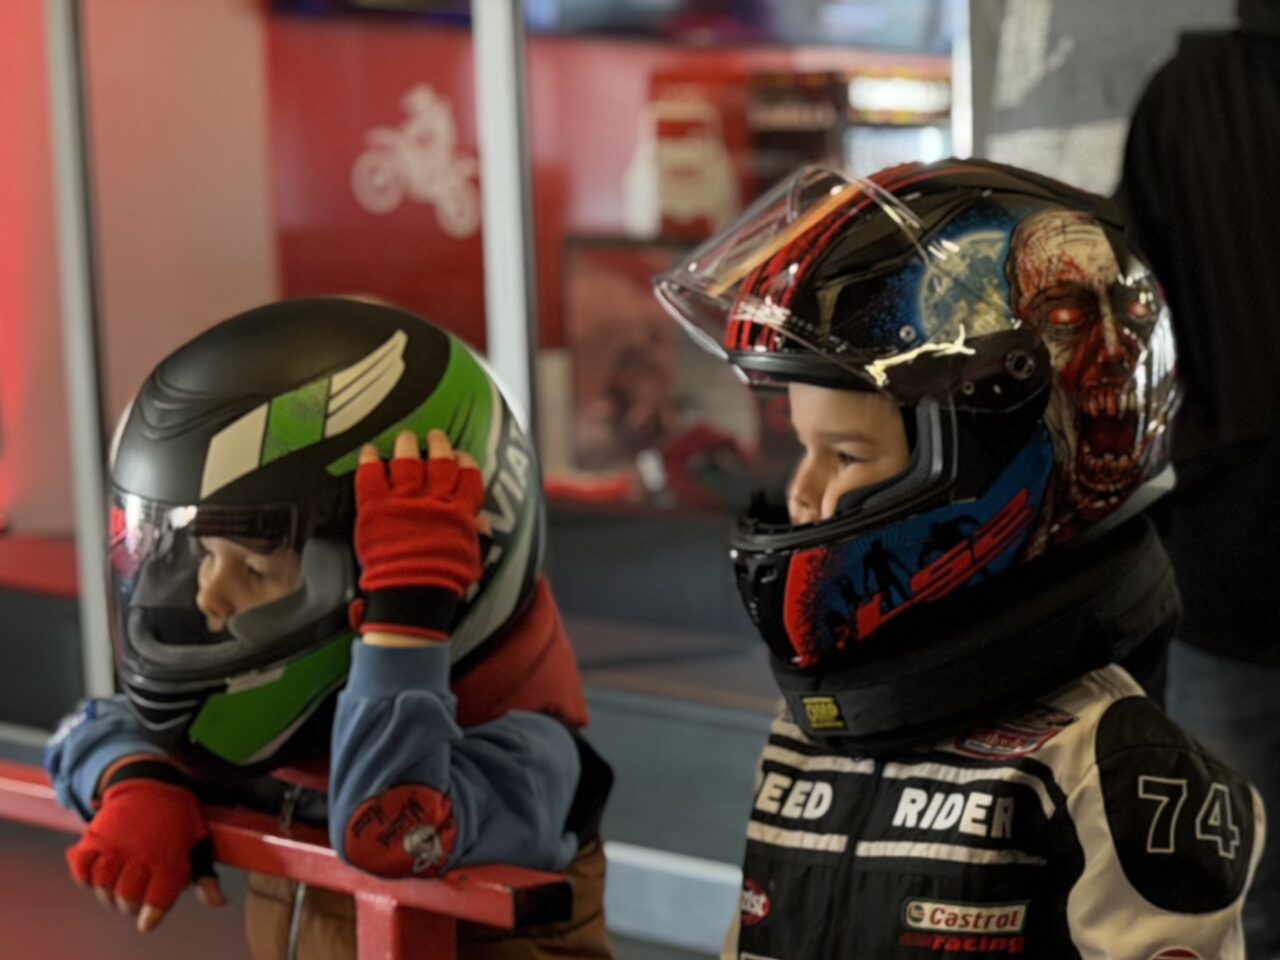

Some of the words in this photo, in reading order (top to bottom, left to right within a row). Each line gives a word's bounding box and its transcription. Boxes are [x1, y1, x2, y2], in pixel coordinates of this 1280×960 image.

[891, 786, 1015, 839] RIDER
[1137, 775, 1242, 860] 74
[929, 907, 1020, 929] Castrol
[930, 935, 1025, 955] racing
